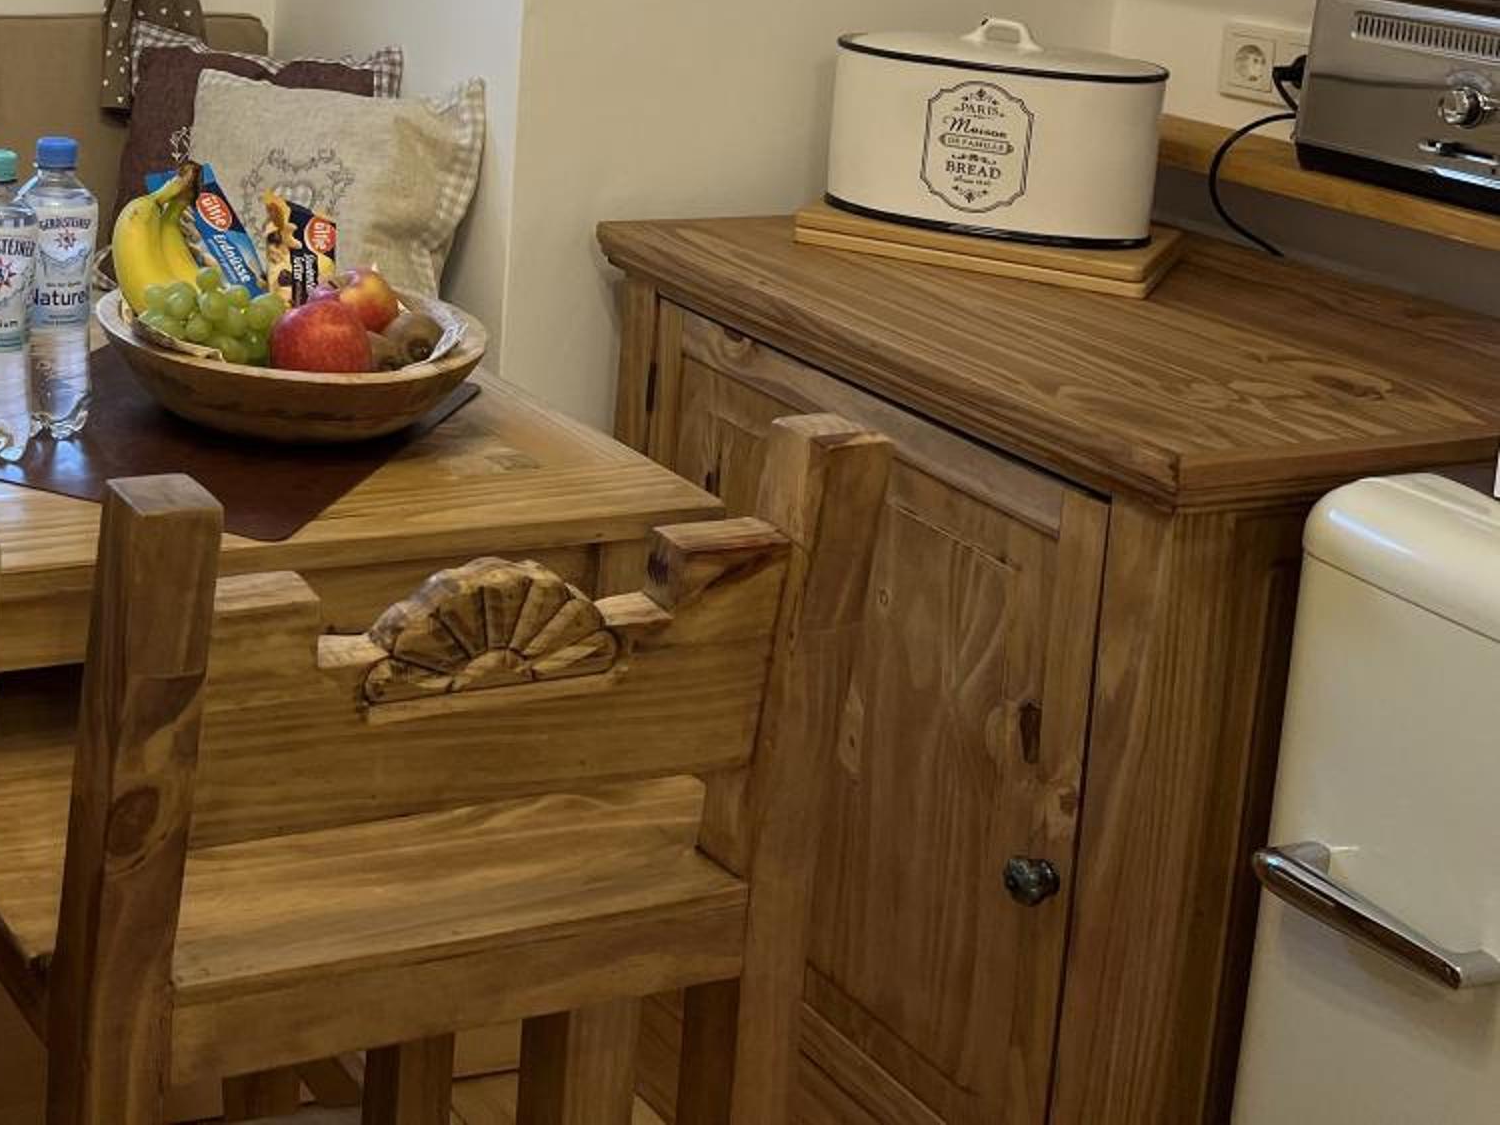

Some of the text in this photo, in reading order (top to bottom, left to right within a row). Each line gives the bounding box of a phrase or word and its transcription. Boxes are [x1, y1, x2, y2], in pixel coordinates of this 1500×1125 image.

[961, 102, 1000, 116] PARIS
[943, 116, 1007, 138] Maison
[945, 160, 1001, 179] BREAD
